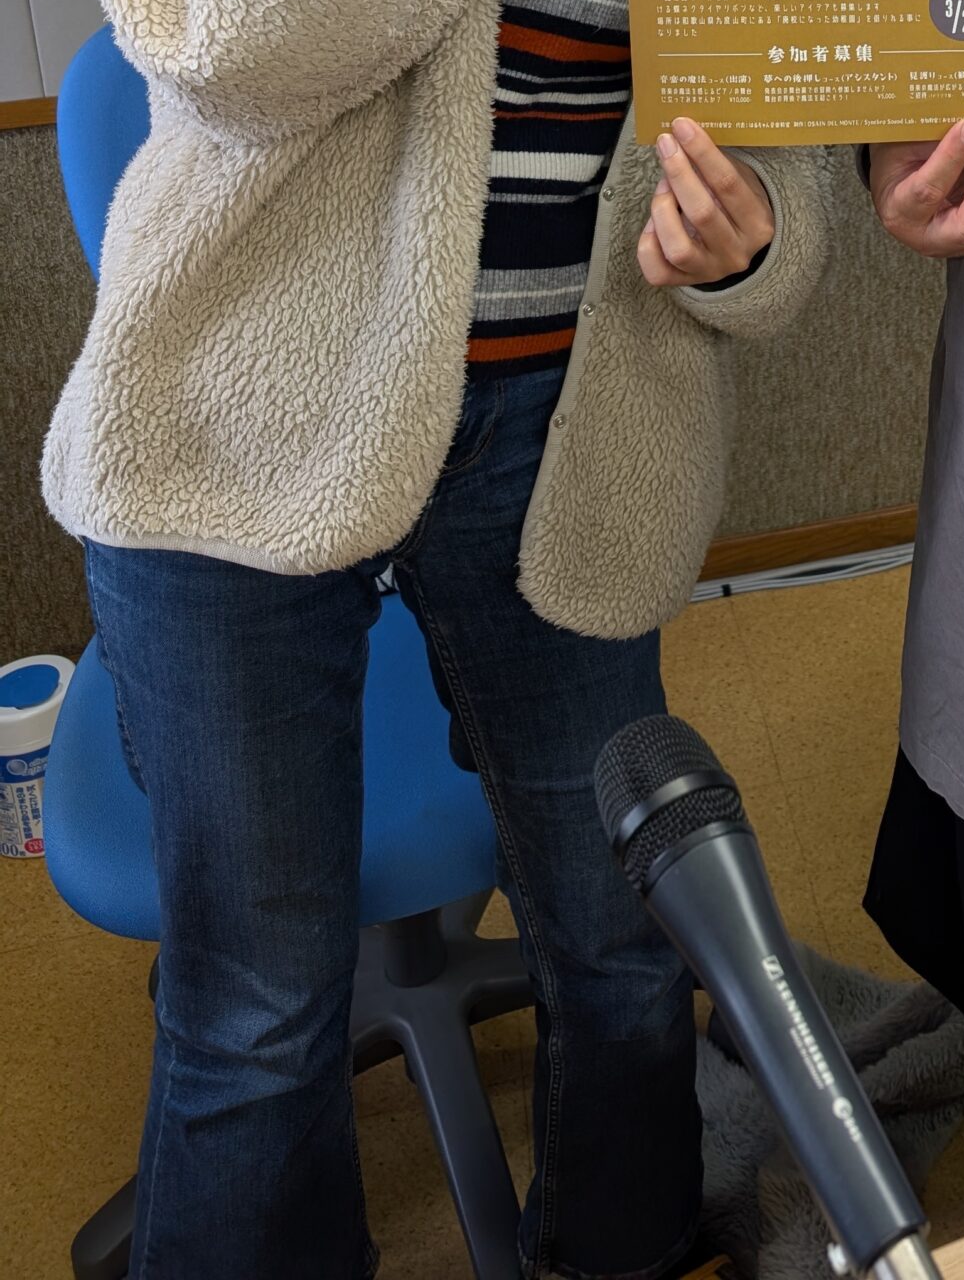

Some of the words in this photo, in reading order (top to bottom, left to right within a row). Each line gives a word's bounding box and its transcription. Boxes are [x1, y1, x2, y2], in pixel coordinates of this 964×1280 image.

[658, 28, 698, 37] なりました
[768, 43, 873, 64] 参加者募集
[776, 979, 835, 1087] SENNHEISER
